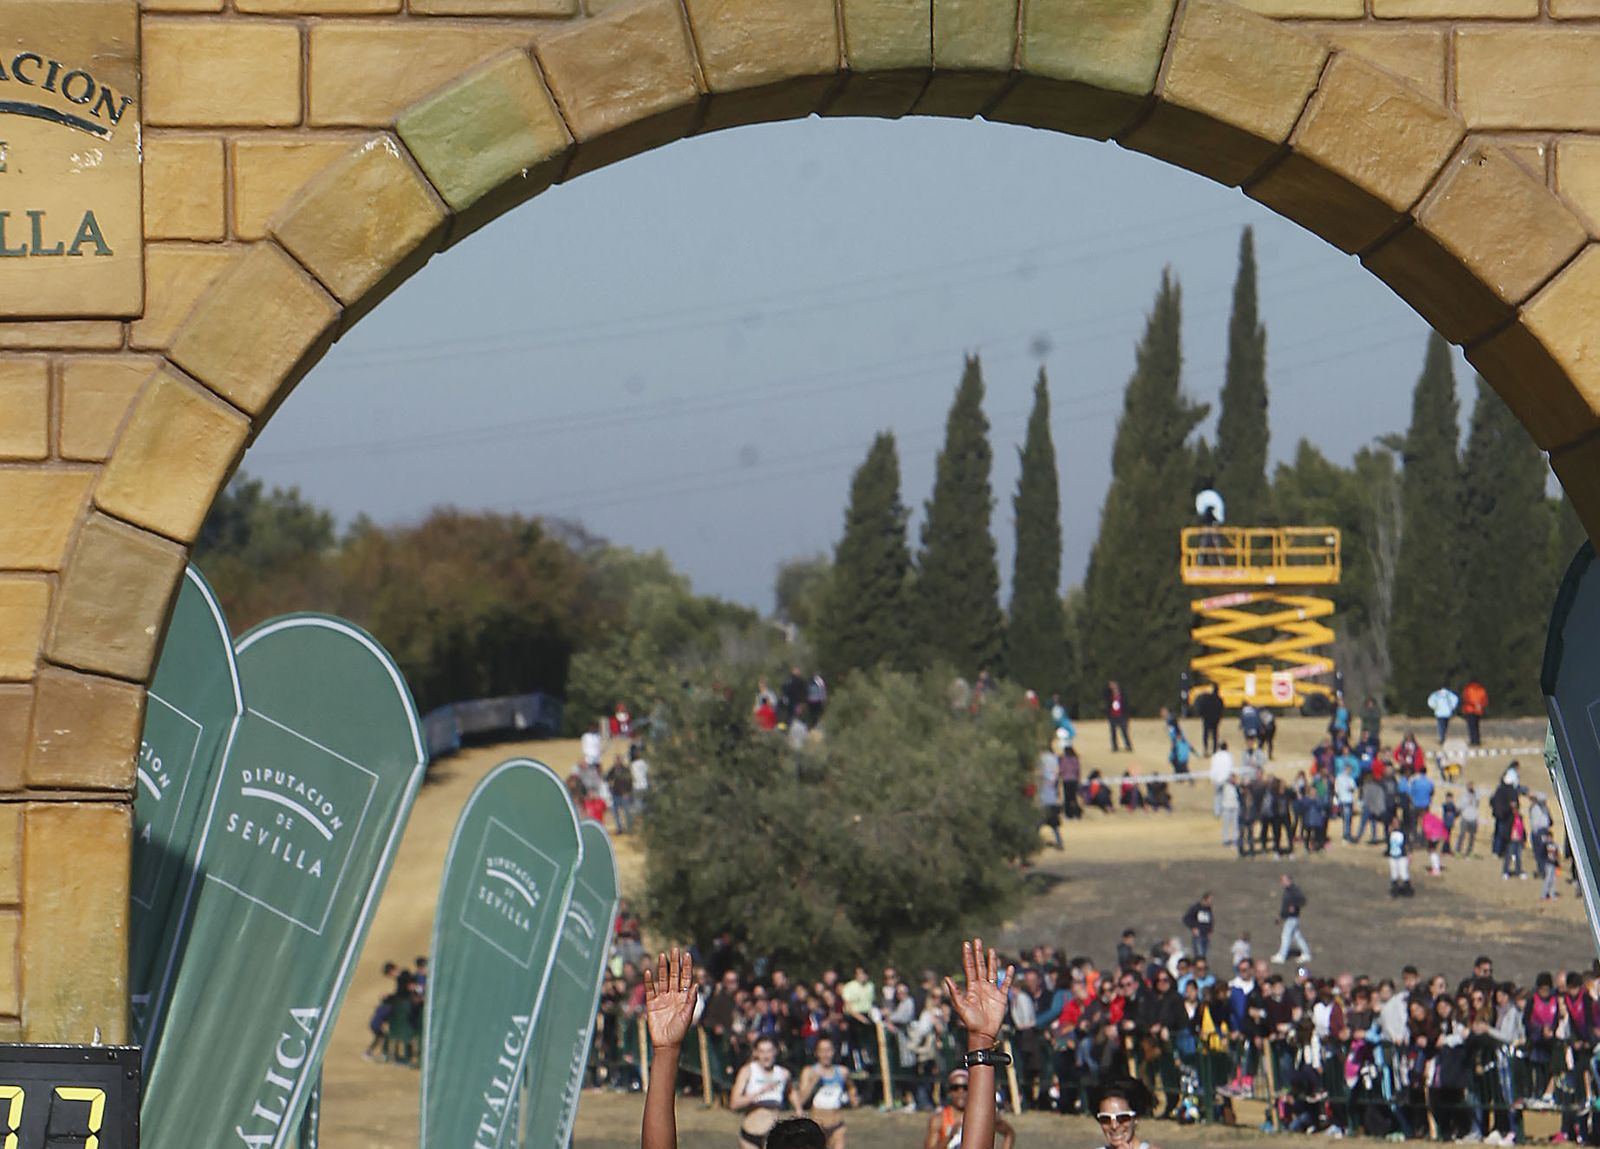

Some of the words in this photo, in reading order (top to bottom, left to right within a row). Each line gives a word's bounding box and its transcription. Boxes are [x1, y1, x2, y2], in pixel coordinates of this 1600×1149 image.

[0, 51, 132, 125] CION
[242, 768, 343, 830] DIPUTACION
[275, 812, 294, 830] DE
[226, 813, 322, 878] SEVILLA
[478, 885, 530, 932] SEVILLA
